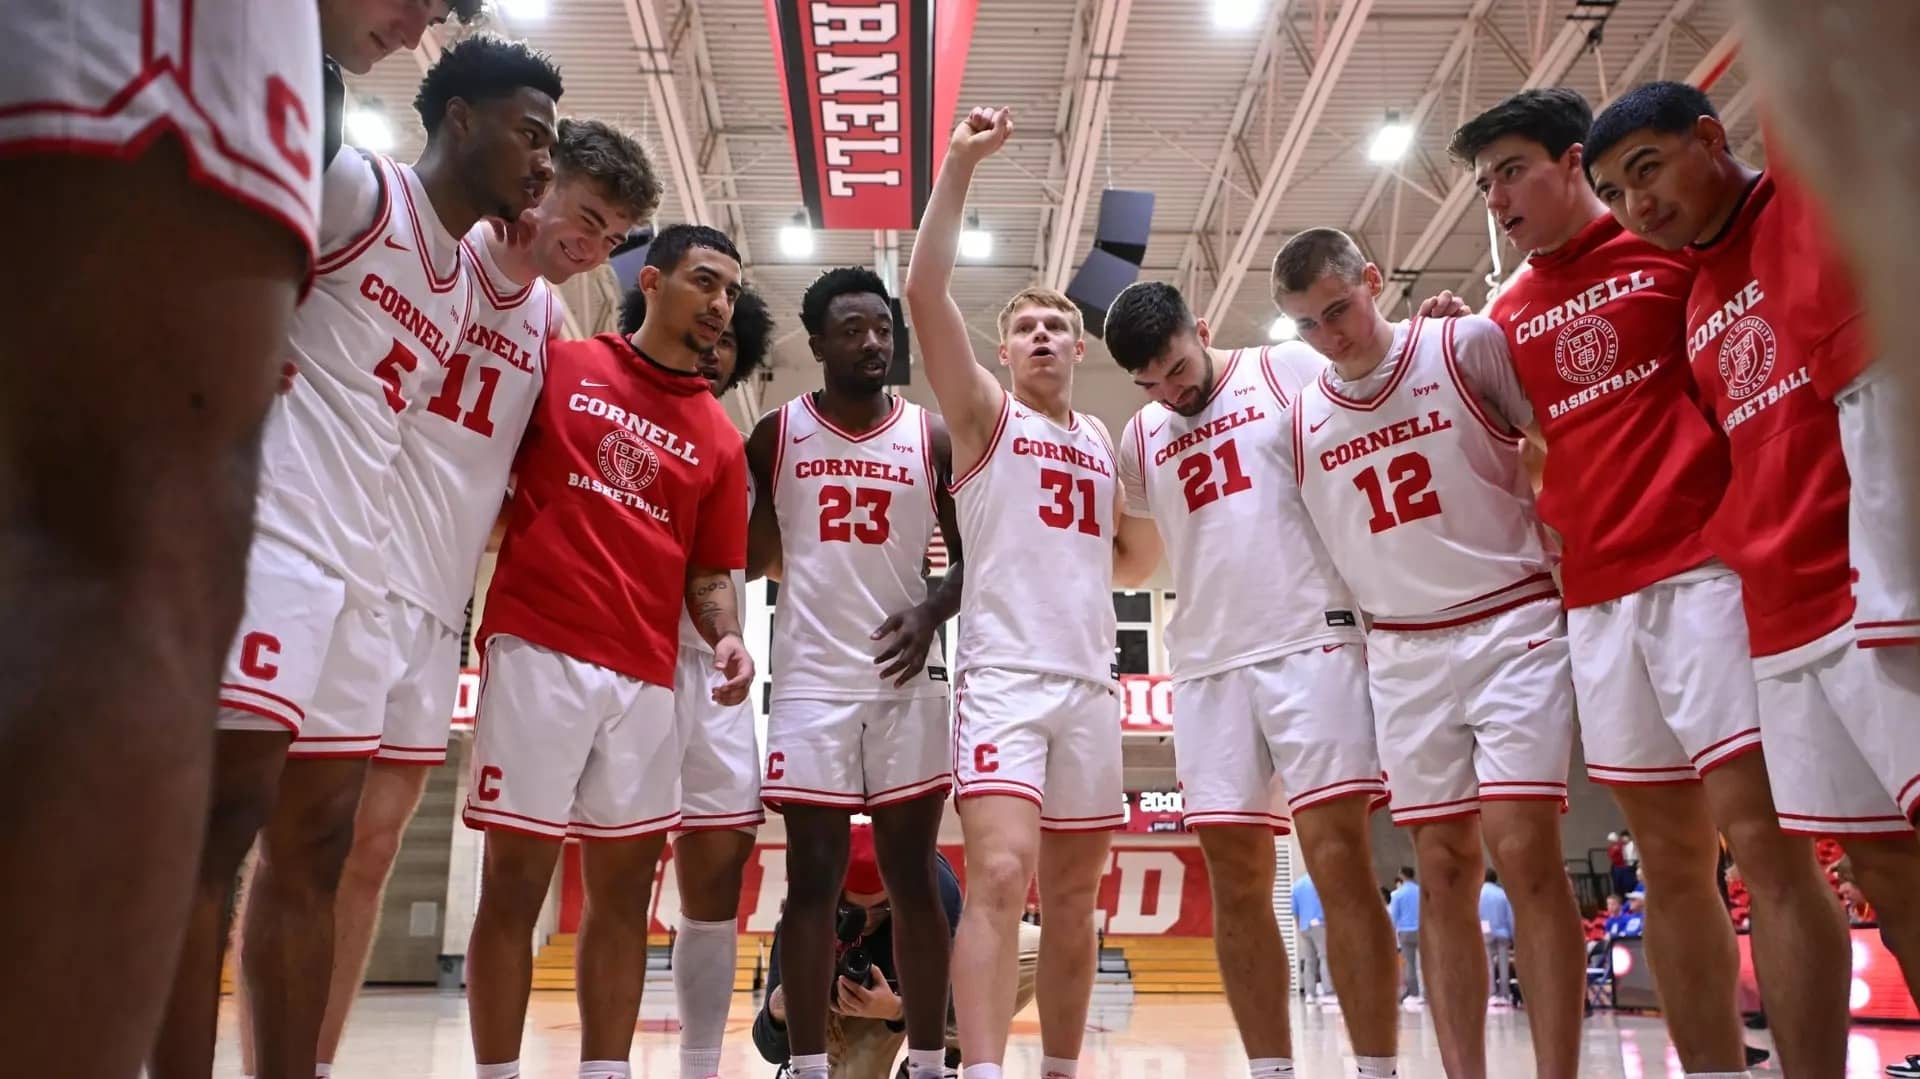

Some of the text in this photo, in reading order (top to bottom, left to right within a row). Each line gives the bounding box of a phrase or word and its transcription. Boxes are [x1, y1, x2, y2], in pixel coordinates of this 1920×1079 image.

[265, 74, 312, 181] C
[360, 273, 451, 369] CORNELL
[1516, 270, 1655, 345] CORNELL
[1687, 279, 1764, 364] CORNE
[373, 337, 418, 414] 5
[427, 353, 502, 438] 11
[1548, 359, 1660, 420] BASKETBALL
[568, 393, 700, 467] CORNELL
[1013, 437, 1111, 479] CORNELL
[1154, 406, 1265, 467] CORNELL
[1319, 410, 1453, 472] CORNELL
[568, 472, 670, 523] BASKETBALL
[795, 459, 914, 486] CORNELL
[1038, 467, 1101, 538] 31
[1177, 438, 1253, 514] 21
[1352, 451, 1443, 534] 12
[818, 484, 892, 545] 23
[239, 631, 282, 681] C
[477, 765, 503, 802] C
[767, 751, 785, 780] C
[974, 743, 1000, 774] C
